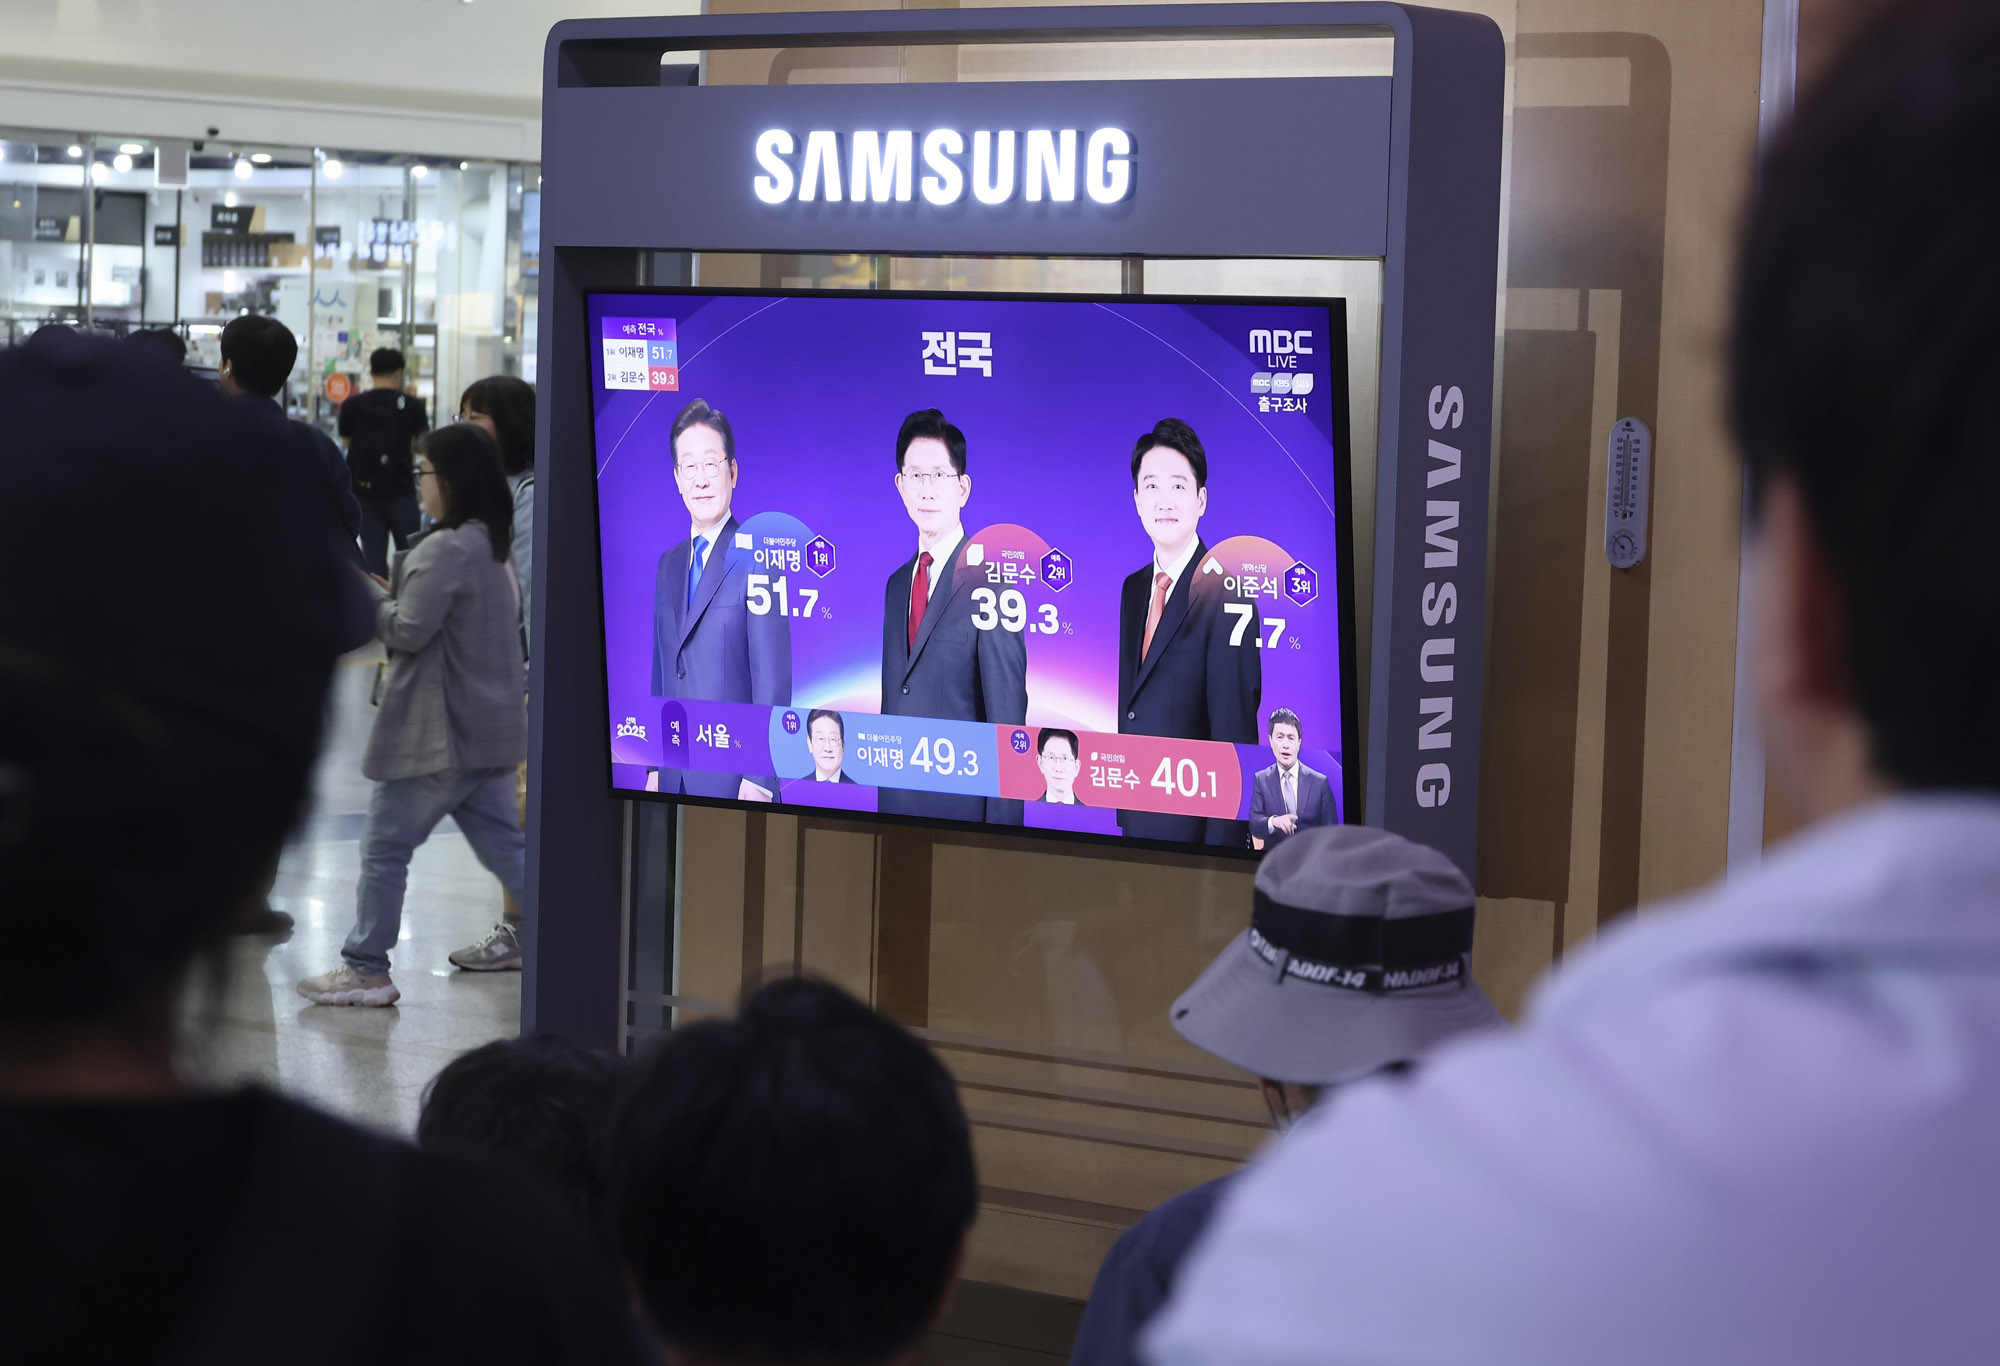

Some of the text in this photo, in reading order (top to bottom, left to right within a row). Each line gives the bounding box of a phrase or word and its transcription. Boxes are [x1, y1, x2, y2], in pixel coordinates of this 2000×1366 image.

[754, 128, 1129, 204] SAMSUNG
[622, 325, 637, 334] 예측
[638, 323, 656, 336] 전국
[1249, 329, 1313, 354] MBC
[619, 347, 644, 359] 이재명
[652, 347, 672, 360] 51.7
[921, 331, 992, 377] 전국
[1268, 355, 1297, 368] LIVE
[620, 371, 645, 383] 김문수
[652, 371, 674, 385] 39.3
[1252, 379, 1310, 388] MBC KBS SBS
[1258, 396, 1307, 414] 출구조사
[763, 537, 796, 547] 더불어민주당
[754, 548, 801, 572] 이재명
[813, 551, 828, 565] 1위
[1001, 550, 1025, 559] 국민의힘
[1050, 554, 1061, 562] 예측
[985, 562, 1035, 583] 김문수
[1048, 565, 1066, 580] 2위
[1242, 563, 1266, 573] 개혁신당
[1224, 575, 1278, 600] 이준석
[1291, 577, 1311, 594] 3위
[746, 574, 832, 619] 51.7 %
[1416, 385, 1464, 808] SAMSUNG
[971, 587, 1074, 635] 39.3 %
[1223, 603, 1301, 650] 7.7 %
[617, 724, 646, 738] 2025
[670, 720, 680, 747] 예측
[786, 720, 797, 731] 1위
[696, 724, 741, 749] 서울 %
[866, 734, 902, 744] 더불어민주당
[1014, 739, 1027, 750] 2위
[857, 736, 979, 777] 이재명 49.3
[1100, 753, 1125, 763] 국민의힘
[1090, 757, 1217, 798] 김문수 40.1
